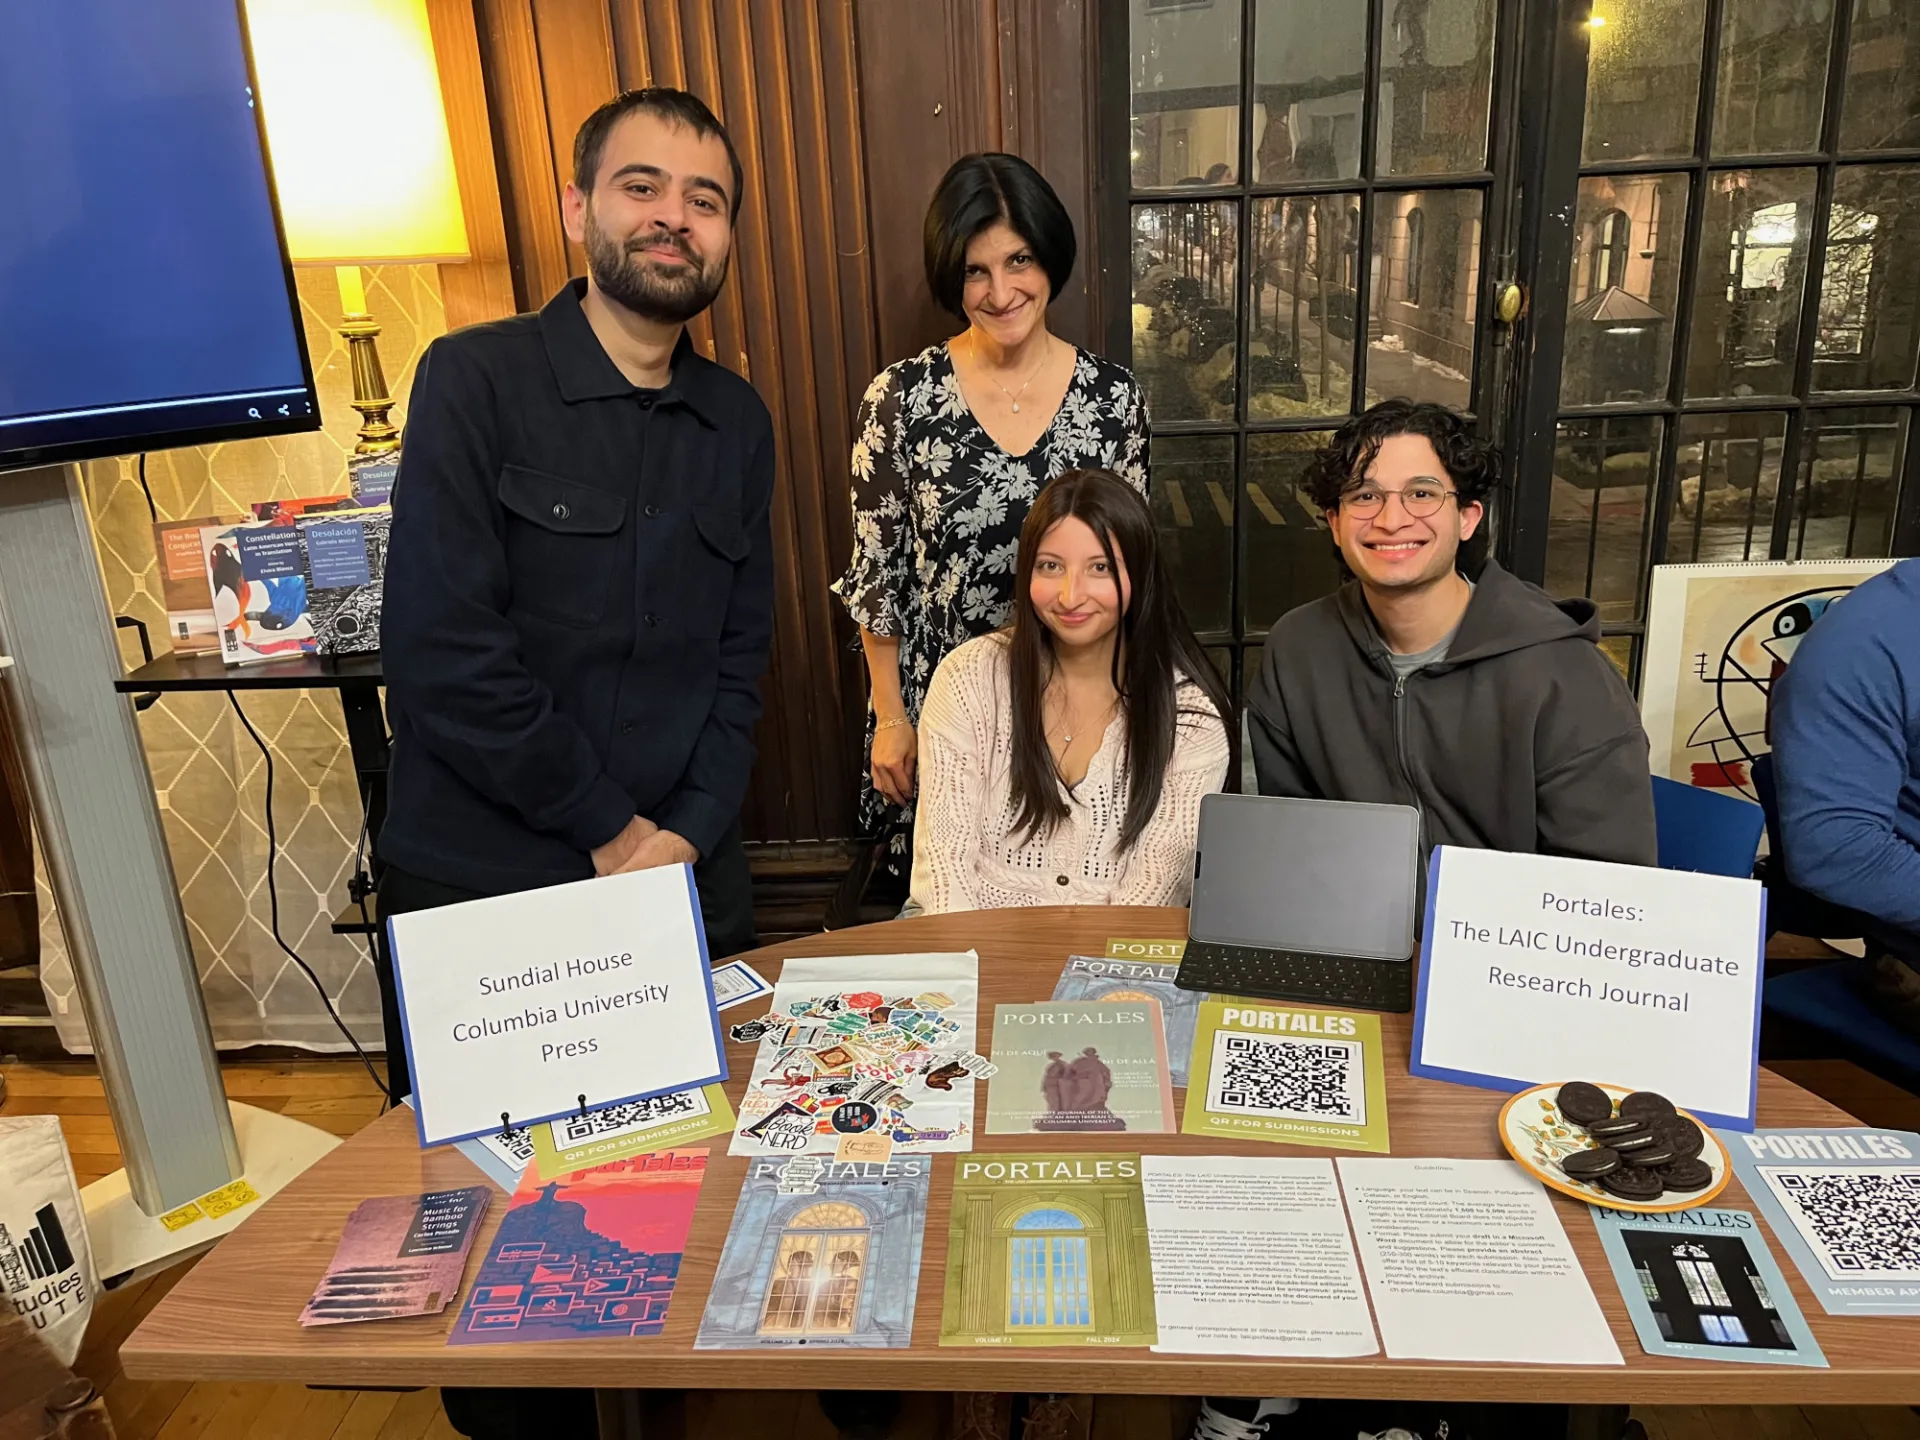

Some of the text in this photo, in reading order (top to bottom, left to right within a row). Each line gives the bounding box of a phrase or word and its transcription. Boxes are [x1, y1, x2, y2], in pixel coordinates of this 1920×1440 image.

[245, 531, 296, 543] Constellation
[311, 528, 358, 539] Desolación
[1542, 892, 1645, 922] Portales:
[1111, 943, 1181, 955] PORT
[1450, 920, 1740, 977] The LAIC Undergraduate
[479, 951, 634, 997] Sundial House
[1489, 965, 1690, 1012] Research Journal
[452, 983, 670, 1042] Columbia University
[1003, 1012, 1145, 1026] PORTALES
[1222, 1008, 1357, 1036] PORTALES
[541, 1036, 599, 1063] Press
[767, 1118, 814, 1135] Book
[1210, 1116, 1361, 1137] QR FOR SUBMISSIONS
[564, 1118, 709, 1161] QR FOR SUBMISSIONS
[760, 1131, 808, 1150] NERD
[1741, 1135, 1913, 1160] PORTALES
[754, 1161, 922, 1180] PTALES
[963, 1161, 1137, 1179] PORTALES
[422, 1205, 468, 1216] Music for
[422, 1213, 464, 1223] Bamboo
[1600, 1208, 1752, 1229] PORTALES
[422, 1221, 458, 1231] Strings
[13, 1272, 81, 1316] tudies
[1827, 1287, 1920, 1296] MEMBER AP
